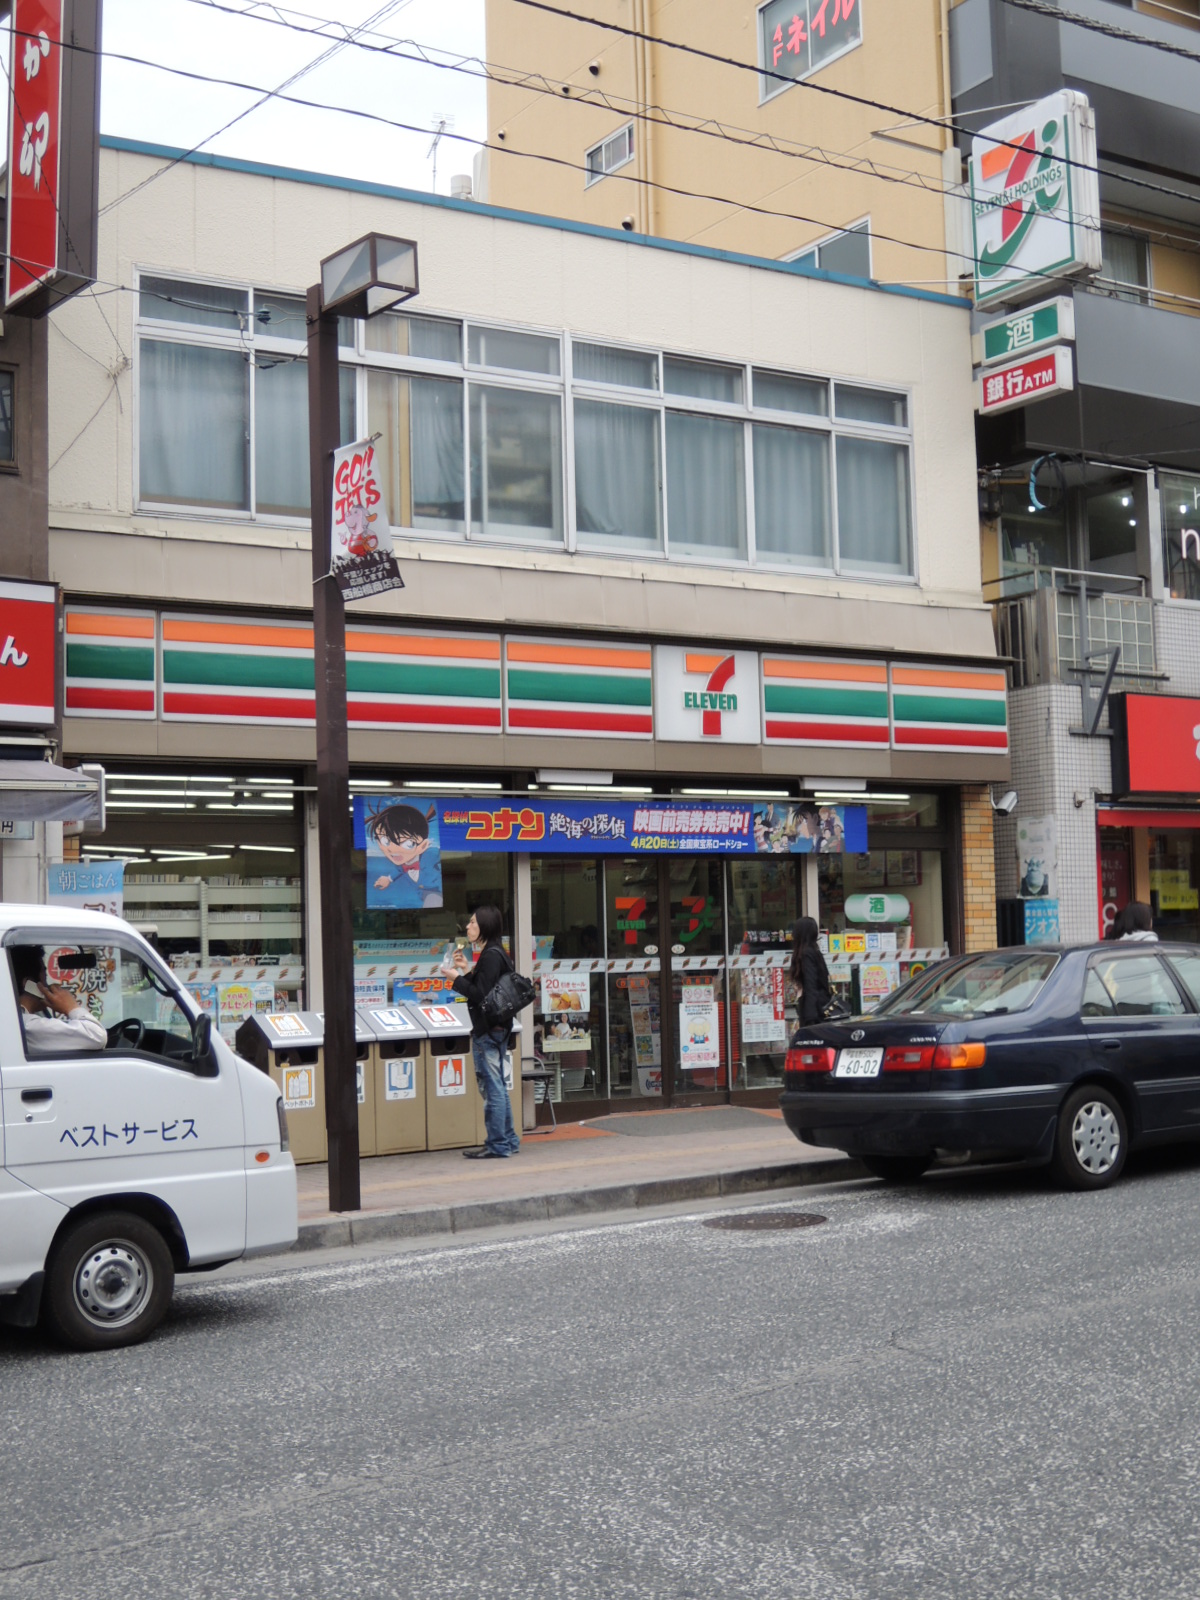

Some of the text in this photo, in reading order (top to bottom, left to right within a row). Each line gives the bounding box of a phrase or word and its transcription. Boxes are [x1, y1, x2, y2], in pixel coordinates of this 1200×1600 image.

[786, 0, 856, 55] ネイル
[1014, 165, 1062, 196] HOLDINGS
[1006, 313, 1035, 352] 酒
[335, 446, 374, 495] GO!!
[335, 478, 381, 526] JETS
[340, 576, 402, 600] 西船橋商店会
[0, 635, 28, 667] ん
[443, 807, 546, 841] 名探偵 コナン
[549, 812, 628, 841] 絶海の探偵
[633, 809, 751, 835] 映画前売券発売中!
[57, 870, 118, 892] 朝ごはん
[869, 897, 885, 914] 酒
[1024, 919, 1059, 935] ジオス
[411, 979, 443, 993] コナン
[846, 1059, 878, 1075] 60-02
[283, 1099, 315, 1108] ペットボトル
[392, 1091, 411, 1099] カン
[442, 1086, 461, 1095] ビン
[59, 1119, 199, 1147] ベストサービス
